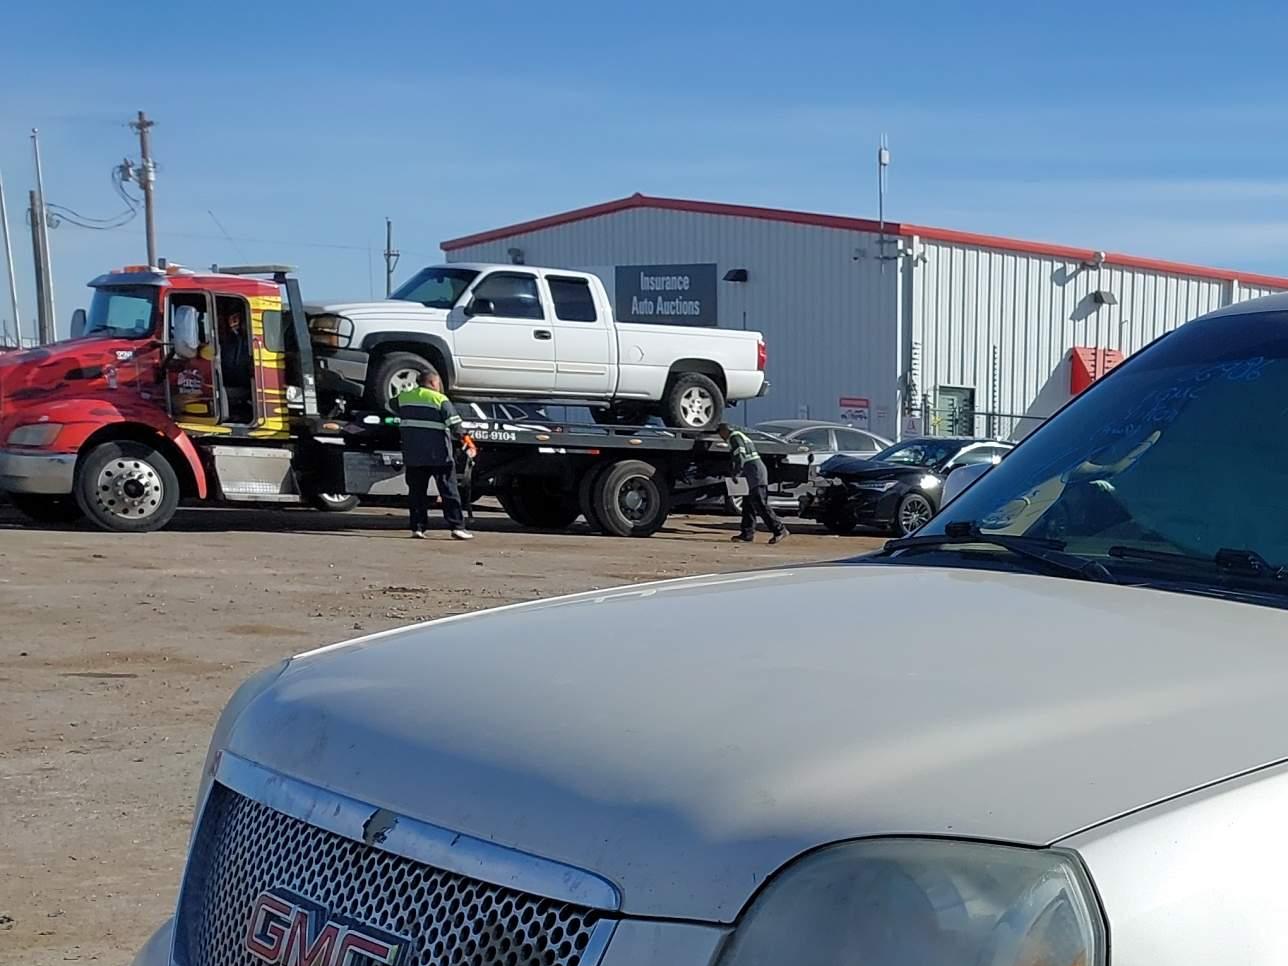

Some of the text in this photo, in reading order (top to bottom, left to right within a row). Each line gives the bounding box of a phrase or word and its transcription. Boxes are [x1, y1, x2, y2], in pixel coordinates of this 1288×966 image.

[640, 272, 690, 290] Insurance
[631, 296, 700, 315] Auto Auctions
